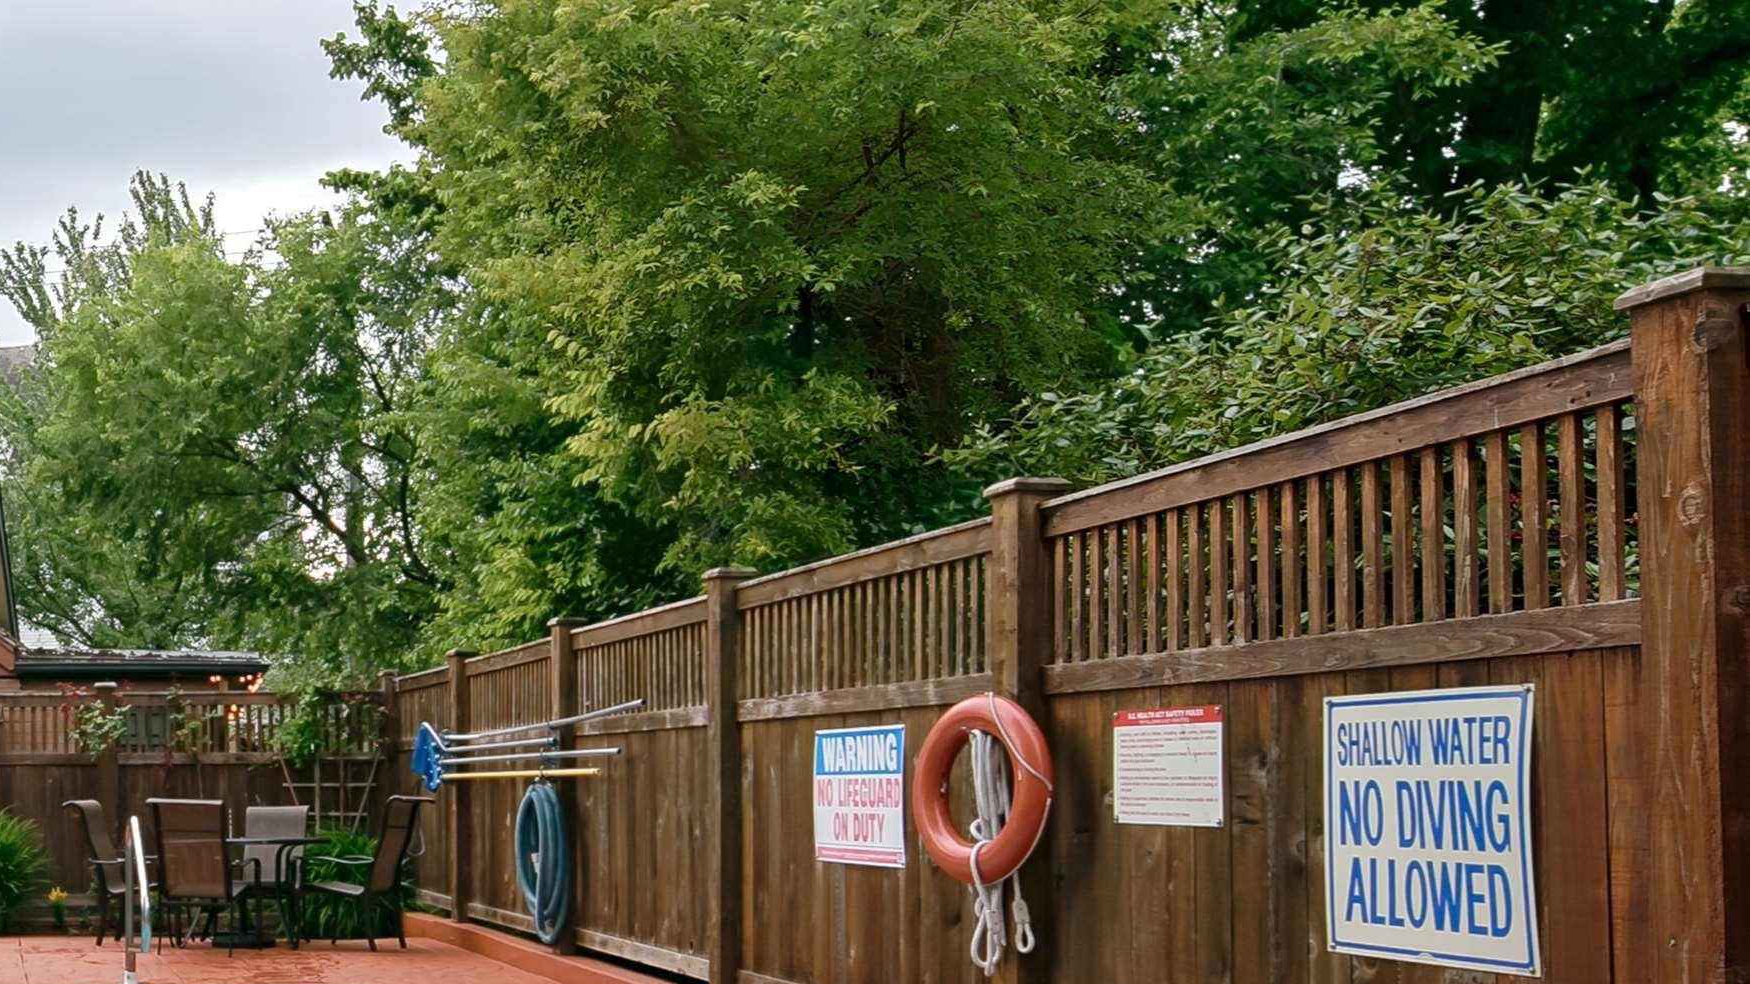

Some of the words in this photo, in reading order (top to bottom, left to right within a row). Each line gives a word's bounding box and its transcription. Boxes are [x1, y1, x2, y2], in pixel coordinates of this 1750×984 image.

[822, 733, 897, 772] WARNING
[1337, 719, 1422, 767] SHALLOW
[1428, 715, 1512, 766] WATER
[817, 778, 834, 807] NO
[838, 777, 900, 809] LIFEGUARD
[833, 812, 849, 842] ON
[853, 812, 885, 844] DUTY
[1339, 780, 1384, 847] NO
[1395, 779, 1512, 854] DIVING
[1345, 856, 1513, 938] ALLOWED
